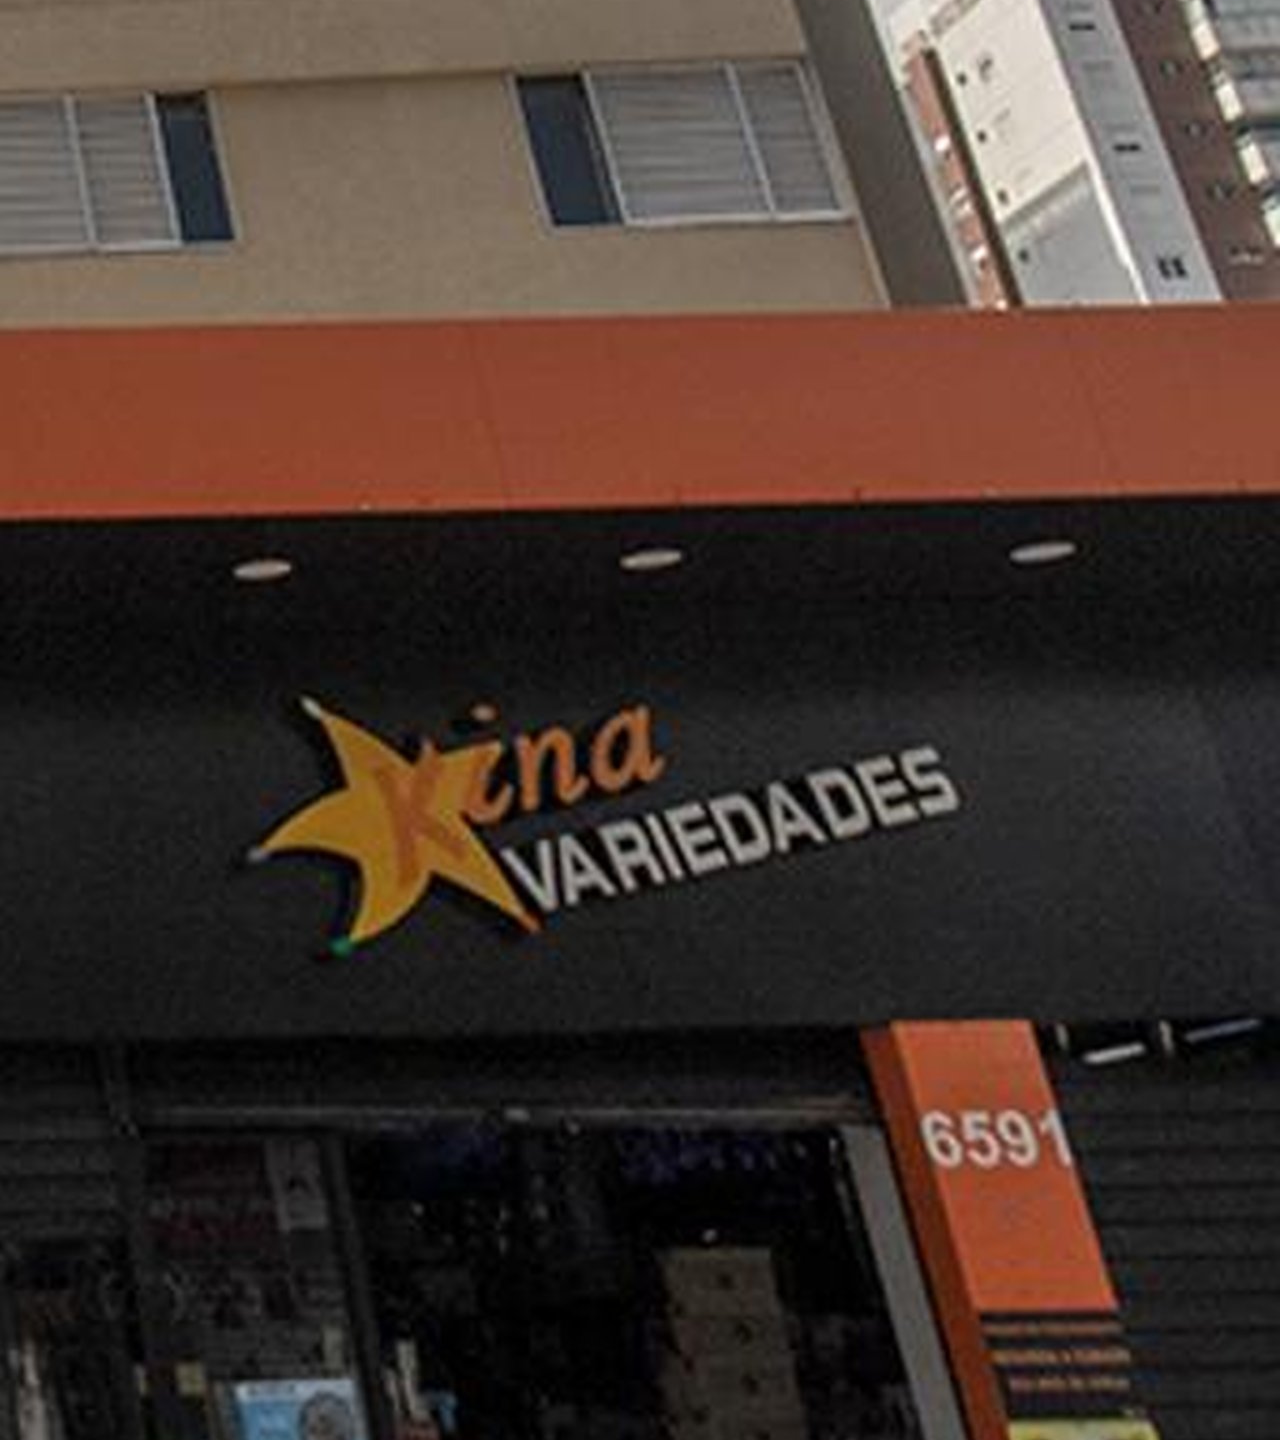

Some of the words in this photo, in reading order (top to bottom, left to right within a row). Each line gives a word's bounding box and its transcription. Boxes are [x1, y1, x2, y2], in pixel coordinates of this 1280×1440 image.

[374, 702, 666, 888] Kina
[502, 745, 960, 914] VARIEDADES
[921, 1109, 1074, 1168] 6591
